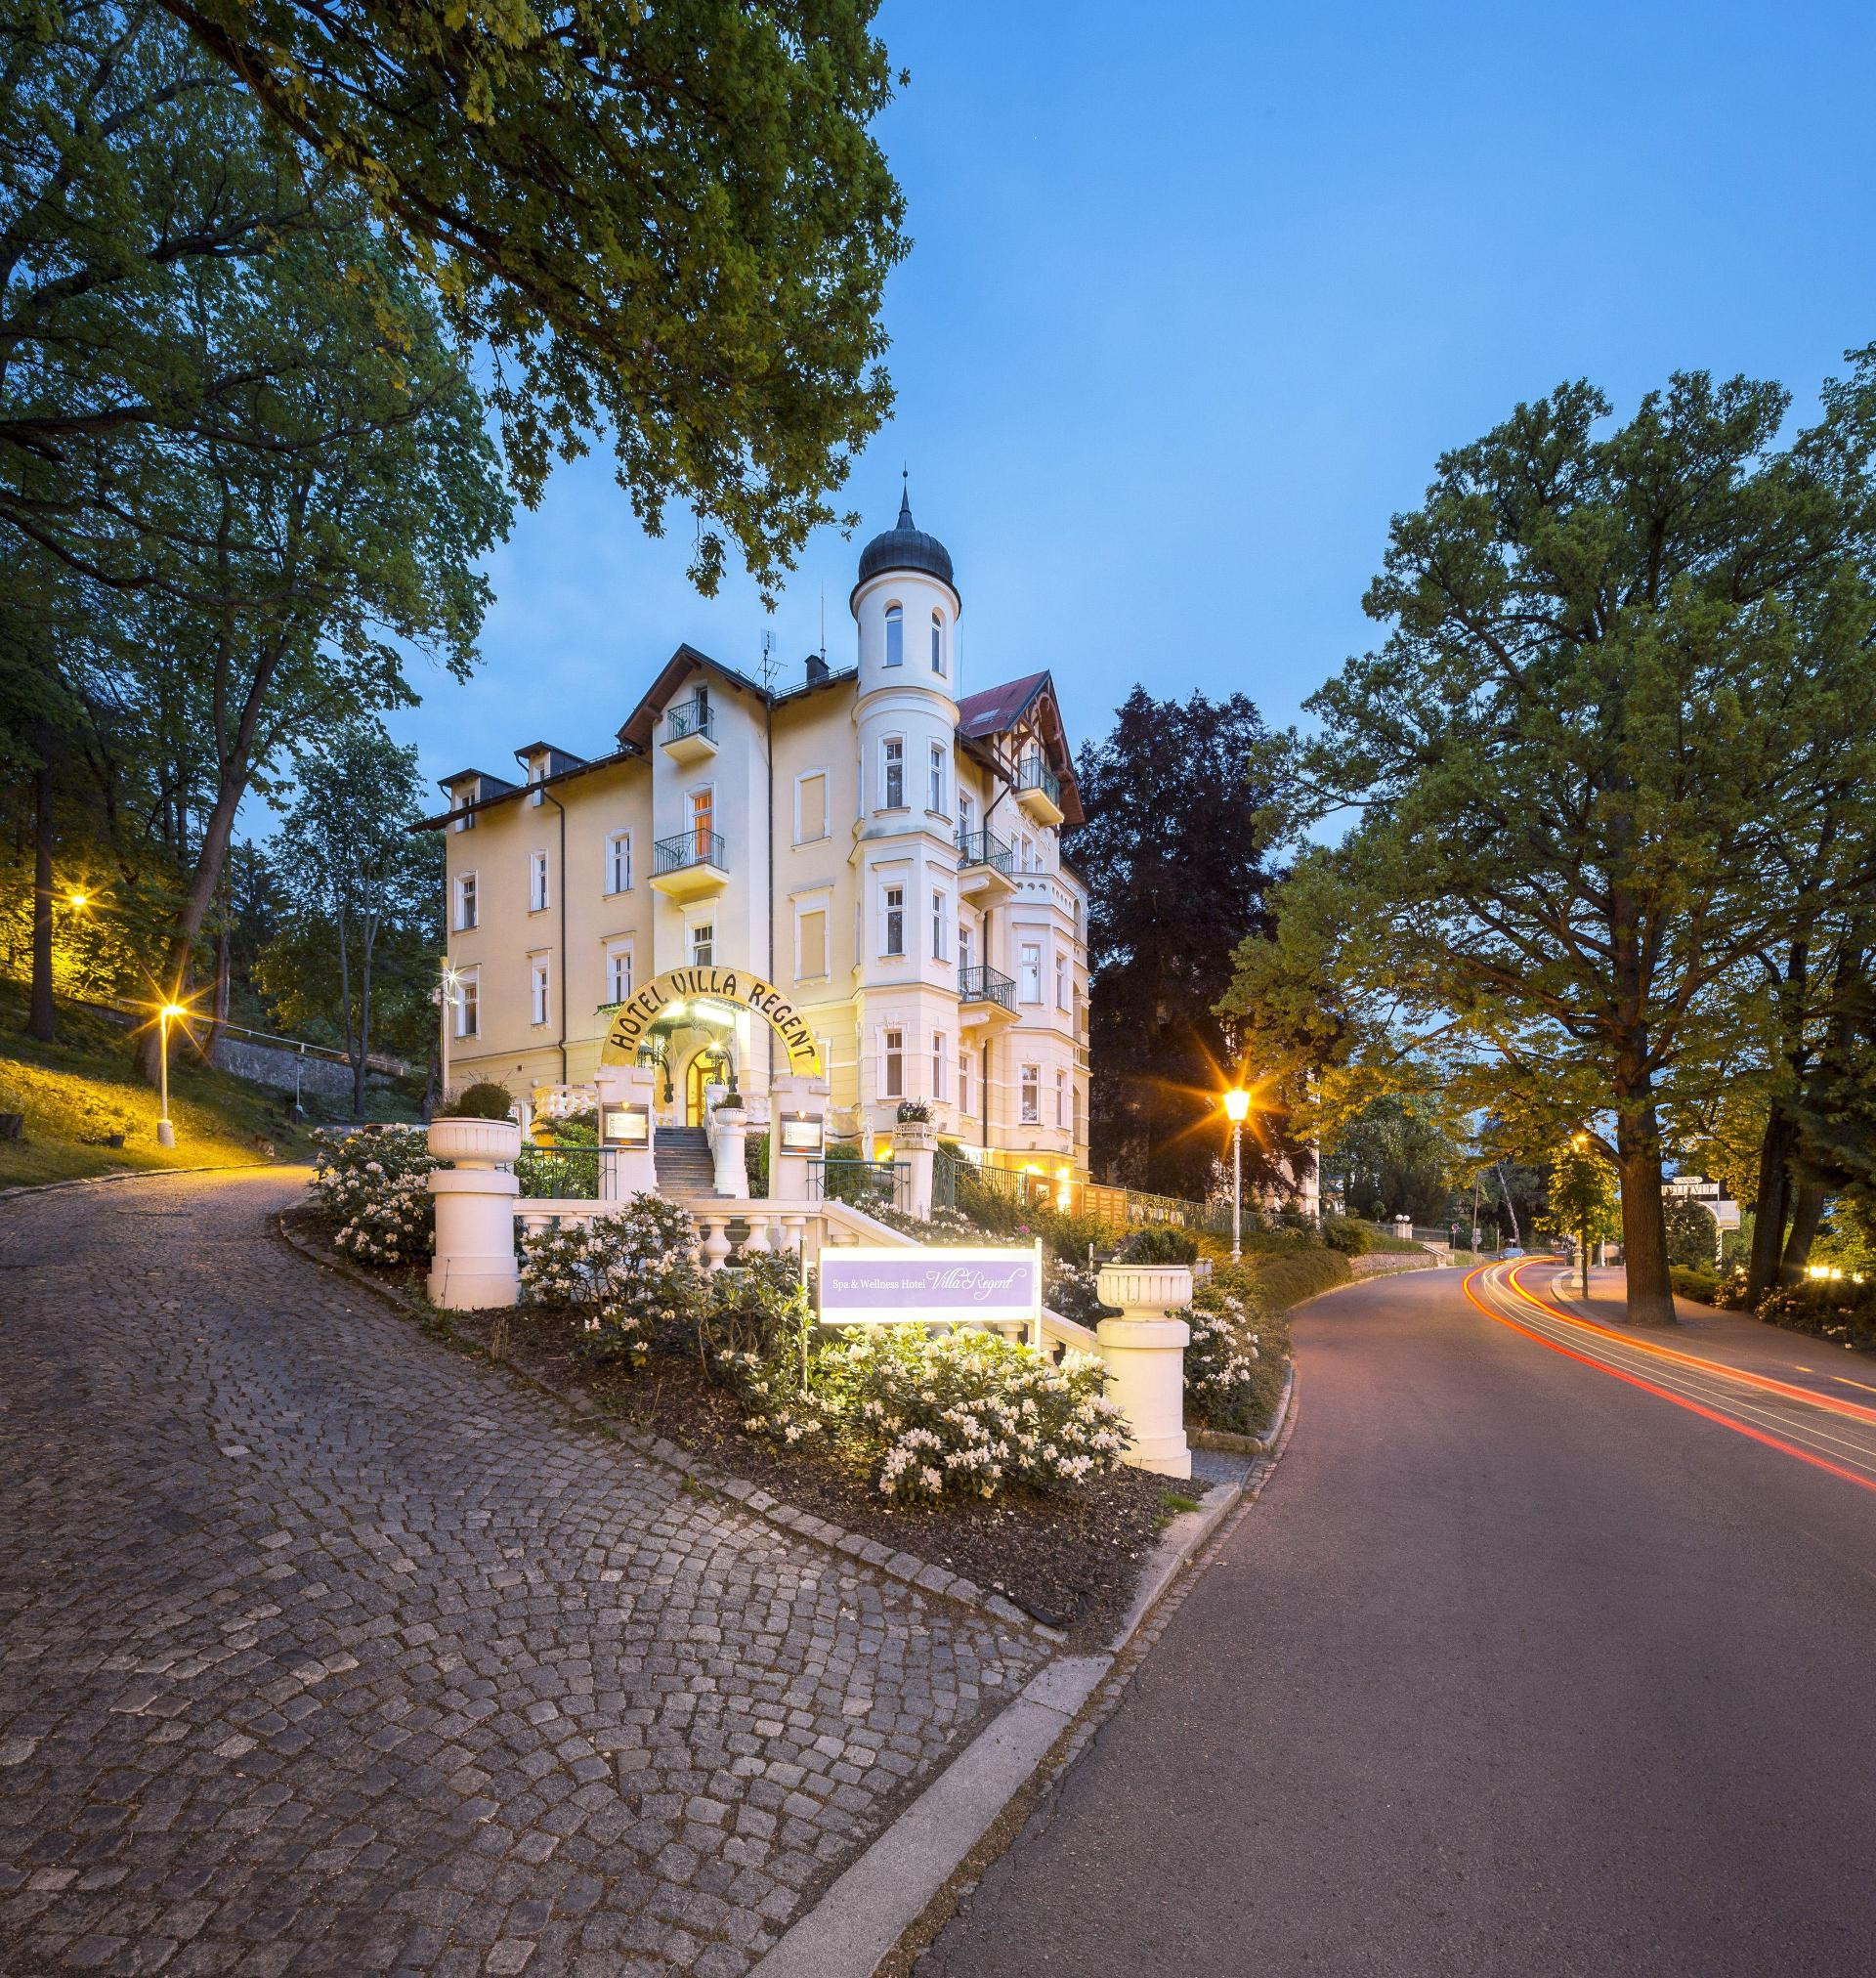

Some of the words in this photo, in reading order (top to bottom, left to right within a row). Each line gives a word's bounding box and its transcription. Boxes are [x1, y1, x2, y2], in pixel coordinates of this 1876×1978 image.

[610, 985, 669, 1052] HOTEL
[670, 969, 737, 997] VILLA
[747, 982, 816, 1059] REGENT
[832, 1278, 849, 1291] Spa
[850, 1278, 858, 1289] &
[860, 1278, 899, 1289] Wellness
[901, 1278, 926, 1289] Hotel
[925, 1268, 963, 1290] Villa
[960, 1268, 1027, 1301] Regent
